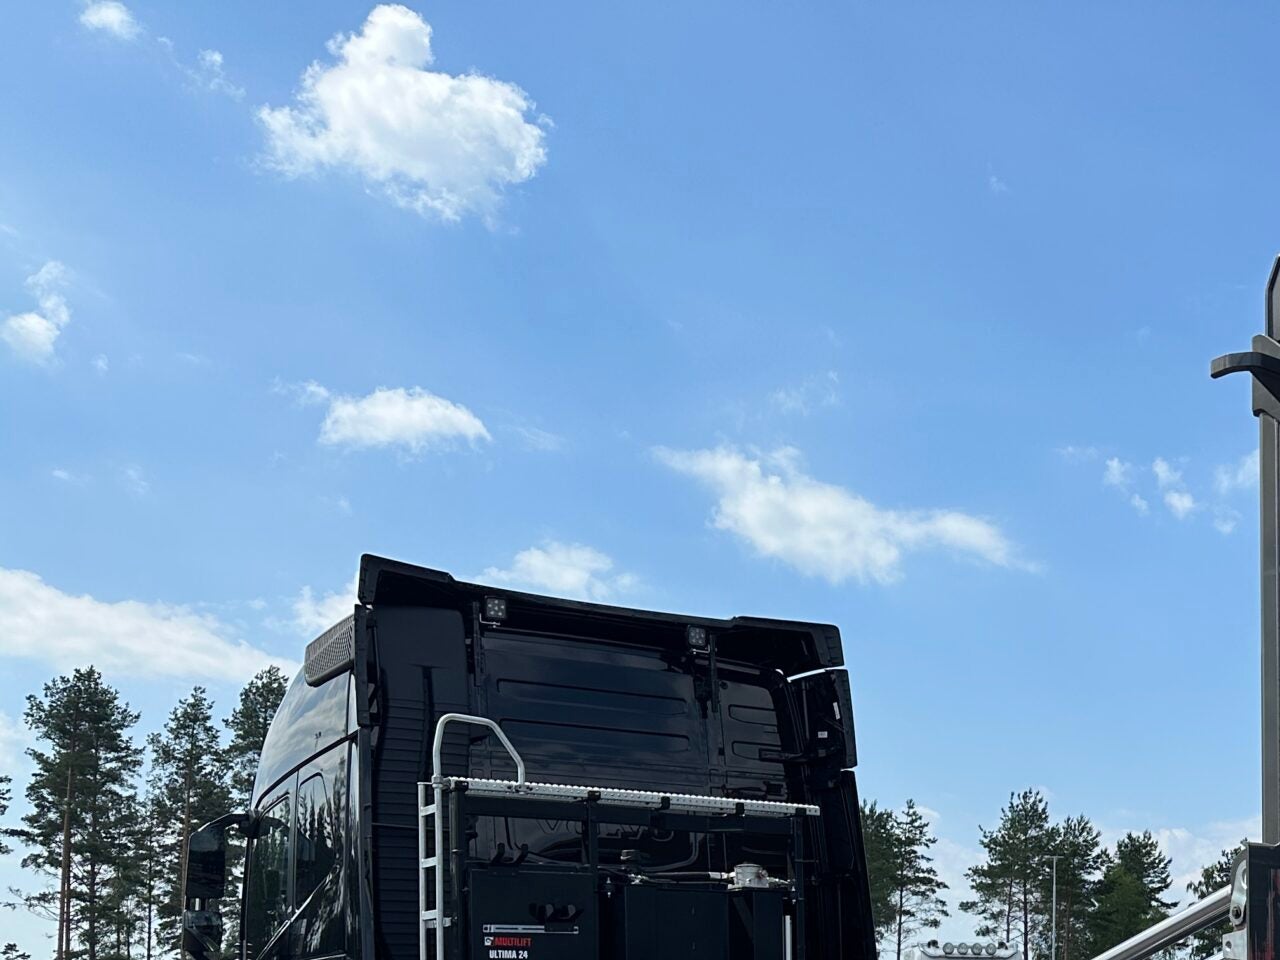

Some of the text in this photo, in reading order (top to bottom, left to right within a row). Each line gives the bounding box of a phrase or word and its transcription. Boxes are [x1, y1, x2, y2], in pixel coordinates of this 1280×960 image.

[494, 936, 532, 947] MULTILIFT
[489, 949, 529, 960] ULTIMA 24
